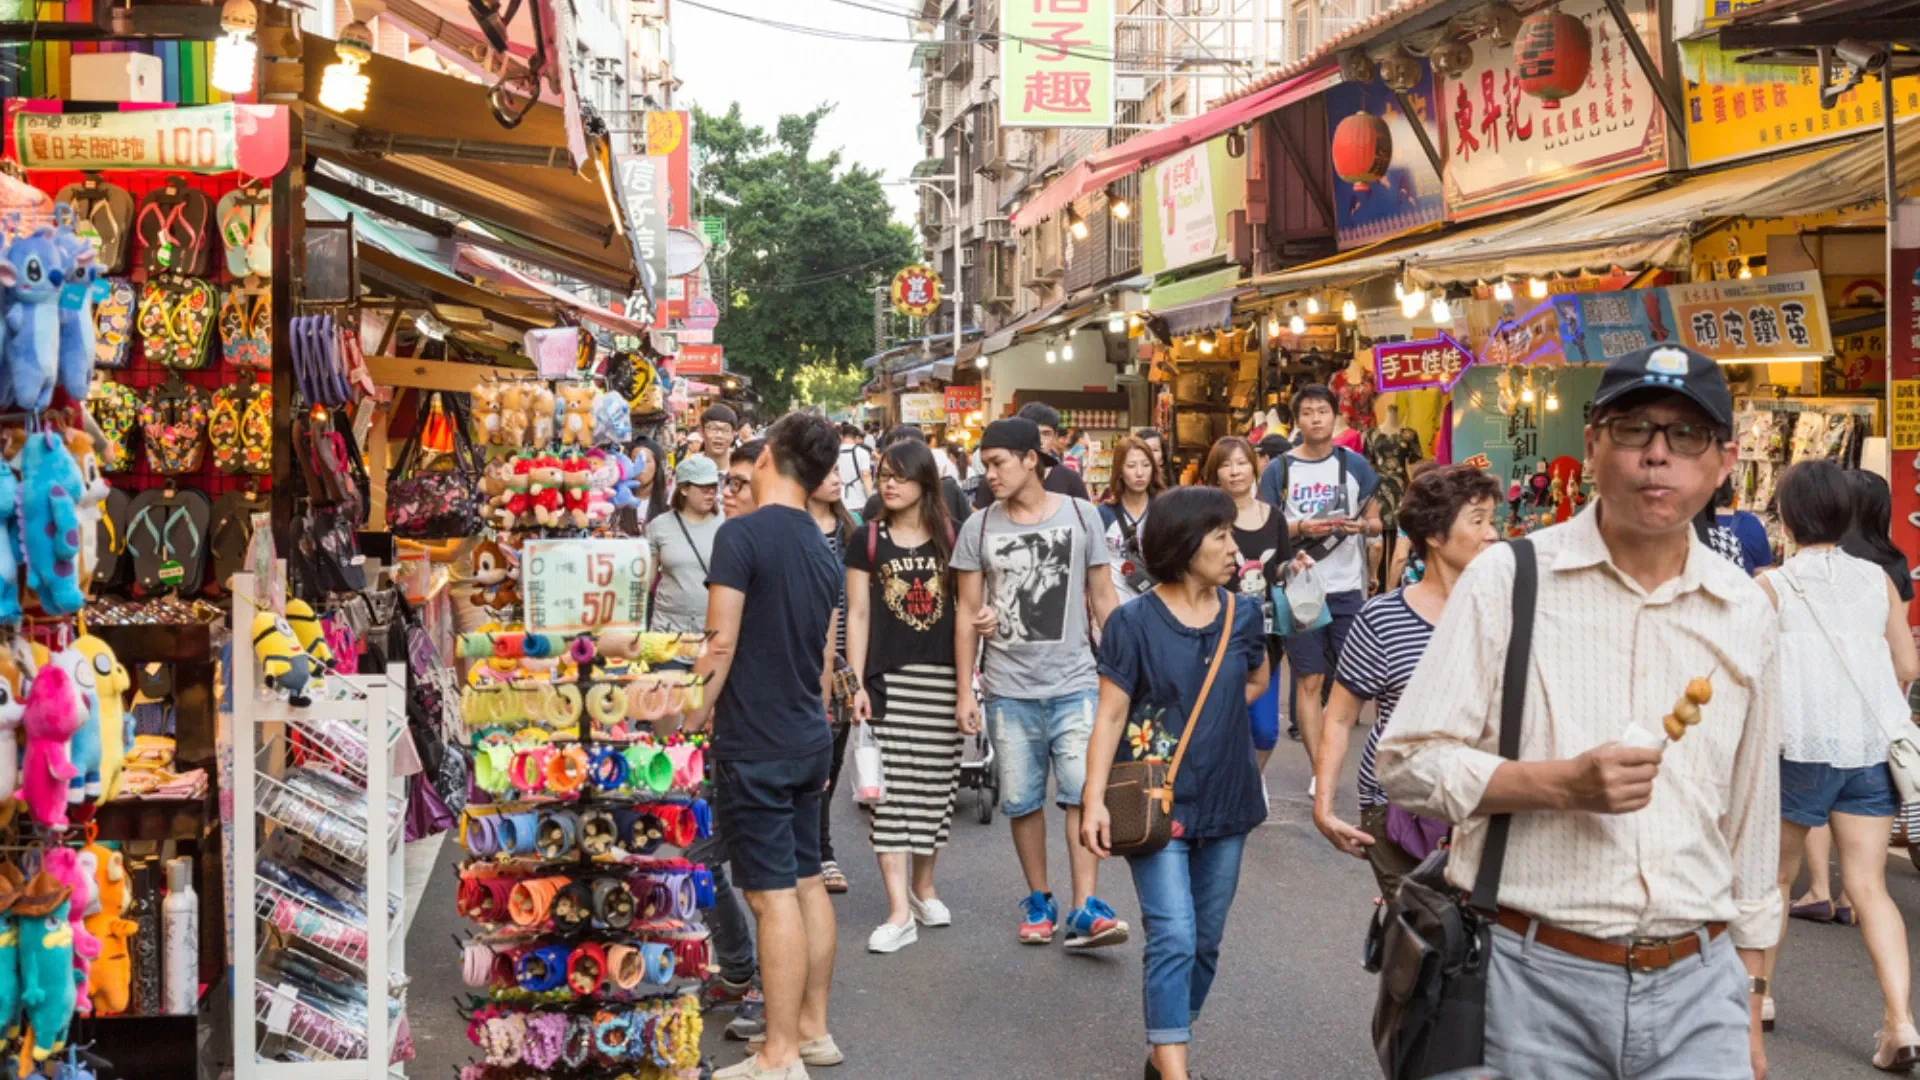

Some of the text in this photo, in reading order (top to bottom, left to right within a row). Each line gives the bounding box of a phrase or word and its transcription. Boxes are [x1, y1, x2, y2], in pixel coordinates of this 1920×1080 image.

[1454, 66, 1534, 160] 東昇記
[30, 126, 217, 168] 夏日夾腳拖 100
[1692, 301, 1810, 348] 頑皮鐵蛋
[1381, 347, 1462, 380] 手工娃娃
[1896, 383, 1920, 398] 誠
[586, 552, 615, 588] 15
[581, 590, 617, 627] 50
